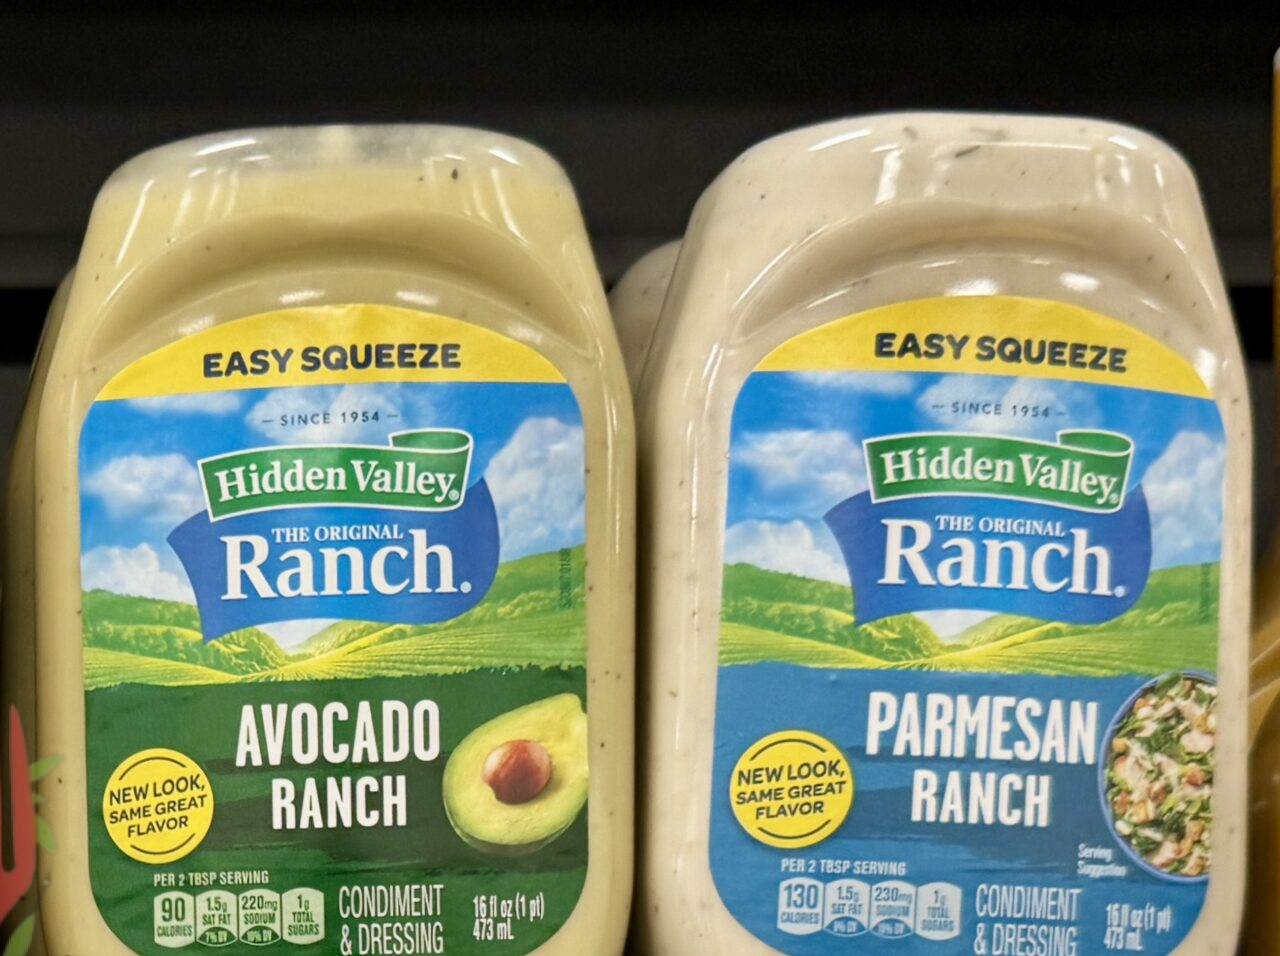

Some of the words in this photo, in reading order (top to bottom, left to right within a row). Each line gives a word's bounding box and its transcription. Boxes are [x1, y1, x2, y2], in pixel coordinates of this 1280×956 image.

[203, 348, 294, 378] EASY
[301, 343, 461, 372] SQUEEZE
[875, 332, 969, 360] EASY
[976, 335, 1127, 372] SQUEEZE
[280, 413, 332, 427] SINCE
[340, 411, 381, 424] 1954
[951, 402, 1003, 416] SINCE
[1011, 405, 1051, 418] 1954
[214, 460, 347, 502] Hidden
[880, 448, 1016, 486] Hidden
[272, 527, 310, 542] THE
[314, 524, 403, 542] ORIGINAL
[935, 515, 975, 531] THE
[979, 517, 1065, 537] ORIGINAL
[235, 700, 440, 767] AVOCADO
[865, 691, 1098, 765] PARMESAN
[737, 766, 780, 786] NEW
[786, 760, 845, 782] LOOK,
[109, 783, 149, 806] NEW
[152, 773, 206, 798] LOOK,
[271, 775, 407, 830] RANCH
[736, 787, 782, 804] SAME
[786, 780, 847, 799] GREAT
[911, 770, 1051, 827] RANCH
[109, 804, 151, 825] SAME
[154, 794, 208, 816] GREAT
[755, 801, 825, 821] FLAVOR
[127, 815, 188, 838] FLAVOR
[154, 873, 175, 886] PER
[178, 873, 185, 886] 2
[188, 871, 216, 886] TBSP
[219, 870, 269, 886] SERVING
[338, 884, 443, 920] CONDIMENT
[975, 883, 1082, 920] CONDIMENT
[340, 928, 353, 955] &
[357, 922, 443, 956] DRESSING
[473, 919, 494, 940] 473
[496, 920, 514, 940] mL
[974, 929, 987, 956] &
